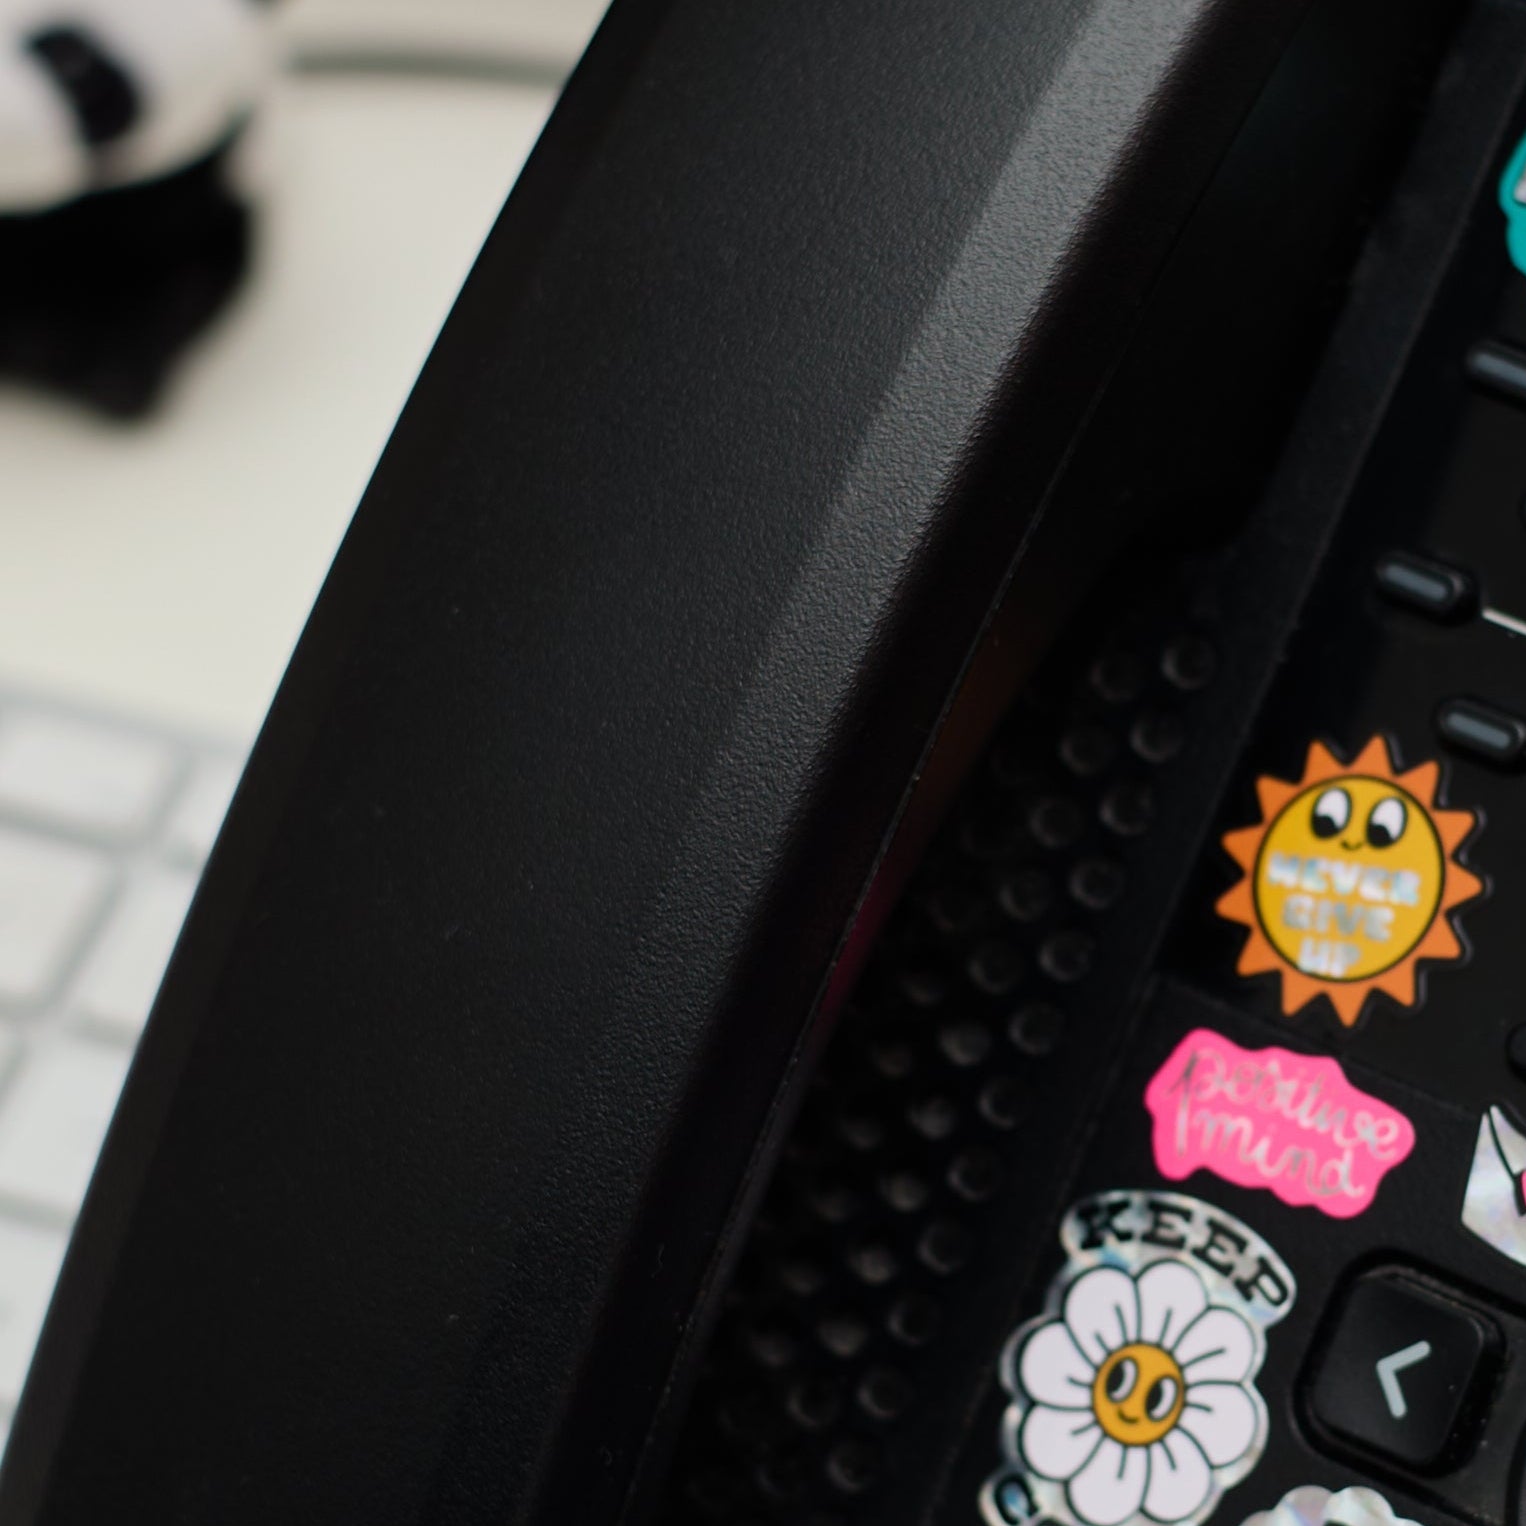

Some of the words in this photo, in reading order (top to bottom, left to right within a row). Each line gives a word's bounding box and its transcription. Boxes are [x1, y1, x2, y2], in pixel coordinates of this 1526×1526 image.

[1267, 850, 1422, 910] NEVER
[1282, 896, 1396, 943] GIVE
[1299, 937, 1363, 980] UP
[1193, 1109, 1366, 1198] mind
[1074, 1200, 1291, 1310] KEEP
